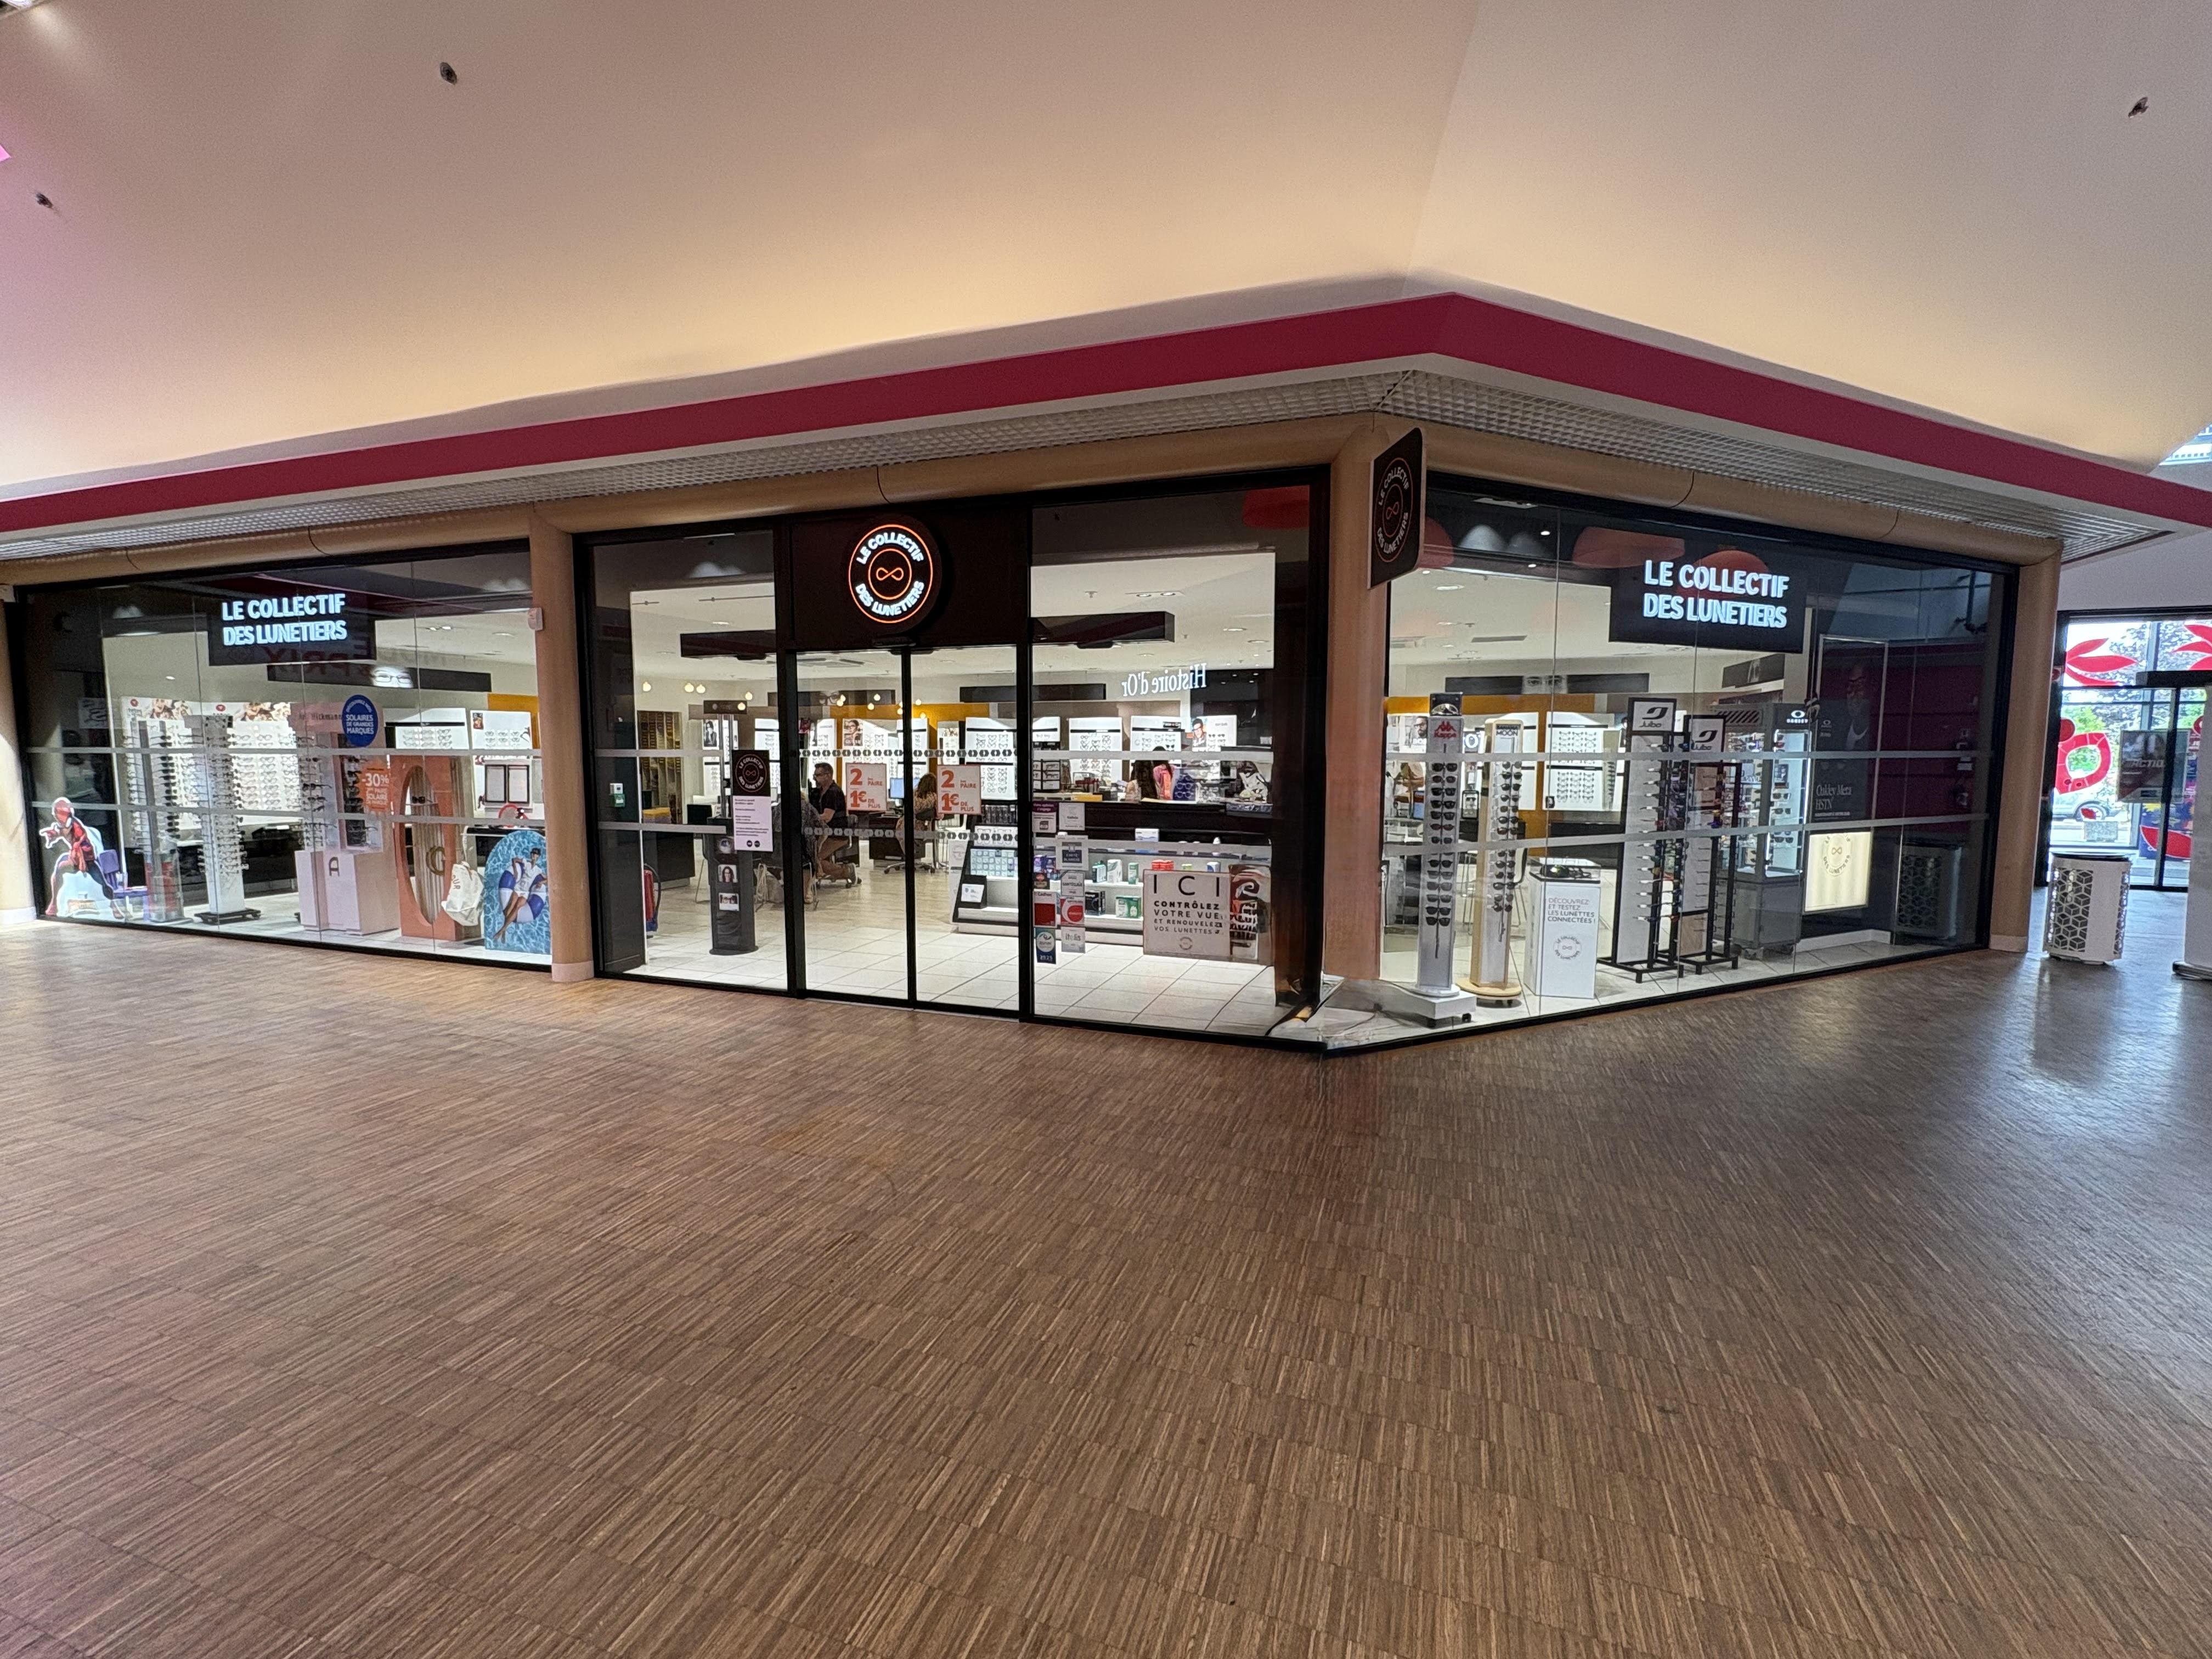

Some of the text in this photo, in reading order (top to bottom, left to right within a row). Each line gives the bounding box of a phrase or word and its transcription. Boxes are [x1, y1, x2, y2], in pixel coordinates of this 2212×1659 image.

[1379, 467, 1409, 506] LE COLLECTIF
[1384, 512, 1408, 554] LUNETIERS
[856, 532, 924, 565] LE COLLECTIF
[1645, 560, 1790, 598] LE COLLECTIF
[222, 593, 346, 620] LE COLLECTIF
[855, 580, 924, 616] DES LUNETIERS
[1643, 592, 1787, 628] DES LUNETIERS
[223, 620, 347, 646] DES LUNETIERS
[1434, 731, 1457, 740] Kappa
[362, 773, 390, 787] -30%
[850, 768, 862, 785] 2
[941, 770, 955, 788] 2
[850, 790, 867, 808] 1€
[1816, 783, 1837, 797] Oakley
[941, 793, 959, 811] 1€
[1154, 900, 1220, 910] CONTRÔLEZ
[1154, 909, 1220, 919] VOTRE VUE
[1166, 919, 1219, 928] RENOUVELEZ
